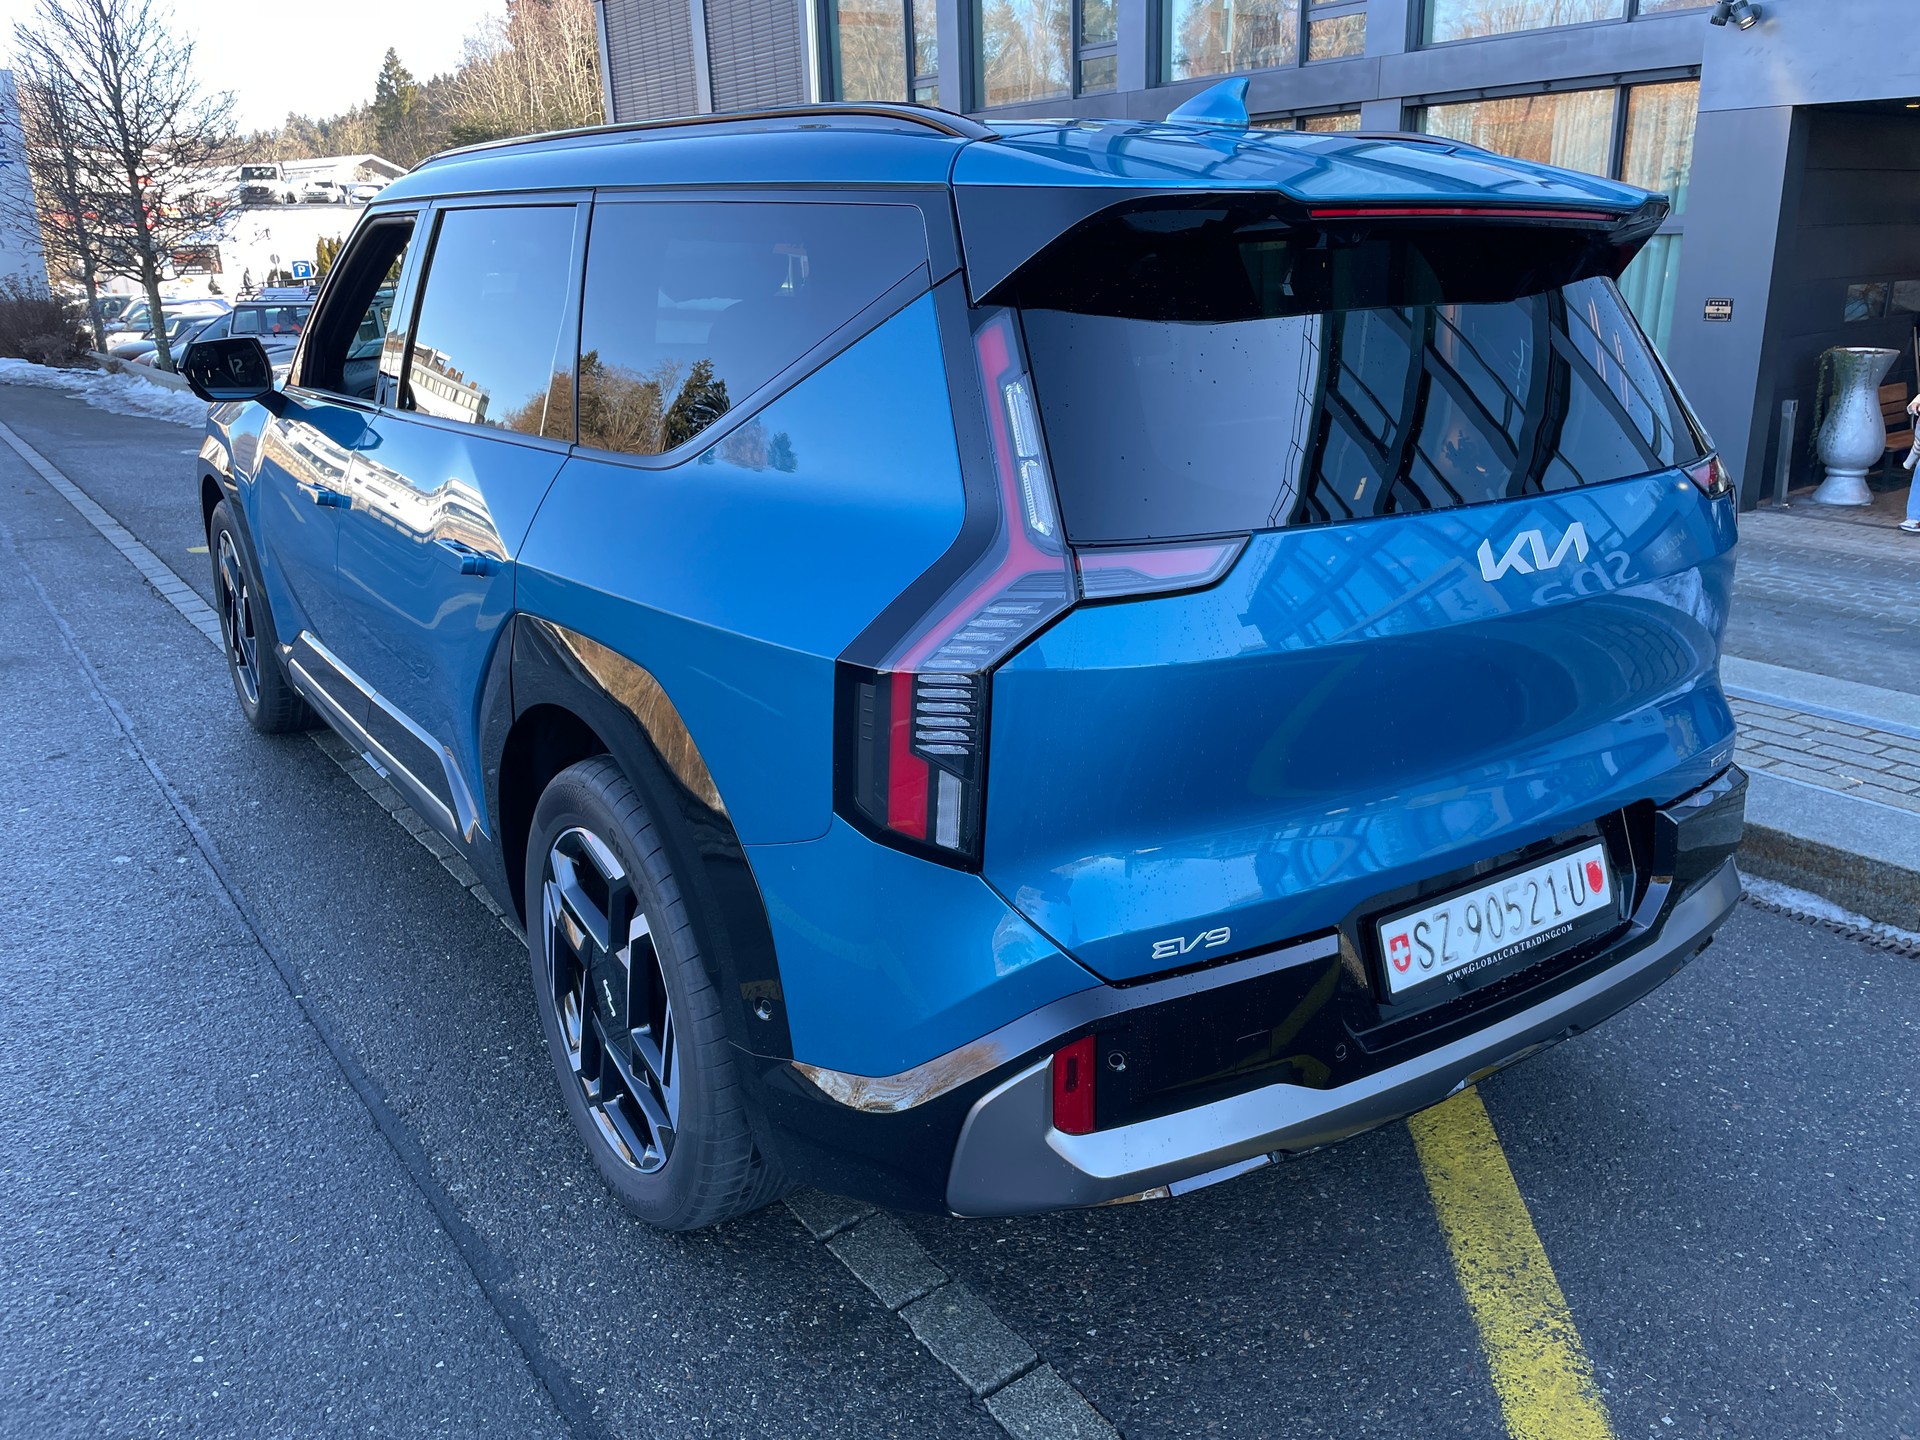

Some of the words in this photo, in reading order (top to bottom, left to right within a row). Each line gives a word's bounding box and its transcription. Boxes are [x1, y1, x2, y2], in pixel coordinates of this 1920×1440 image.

[297, 265, 306, 277] P
[1476, 521, 1590, 582] KIA
[1151, 926, 1231, 960] EV9
